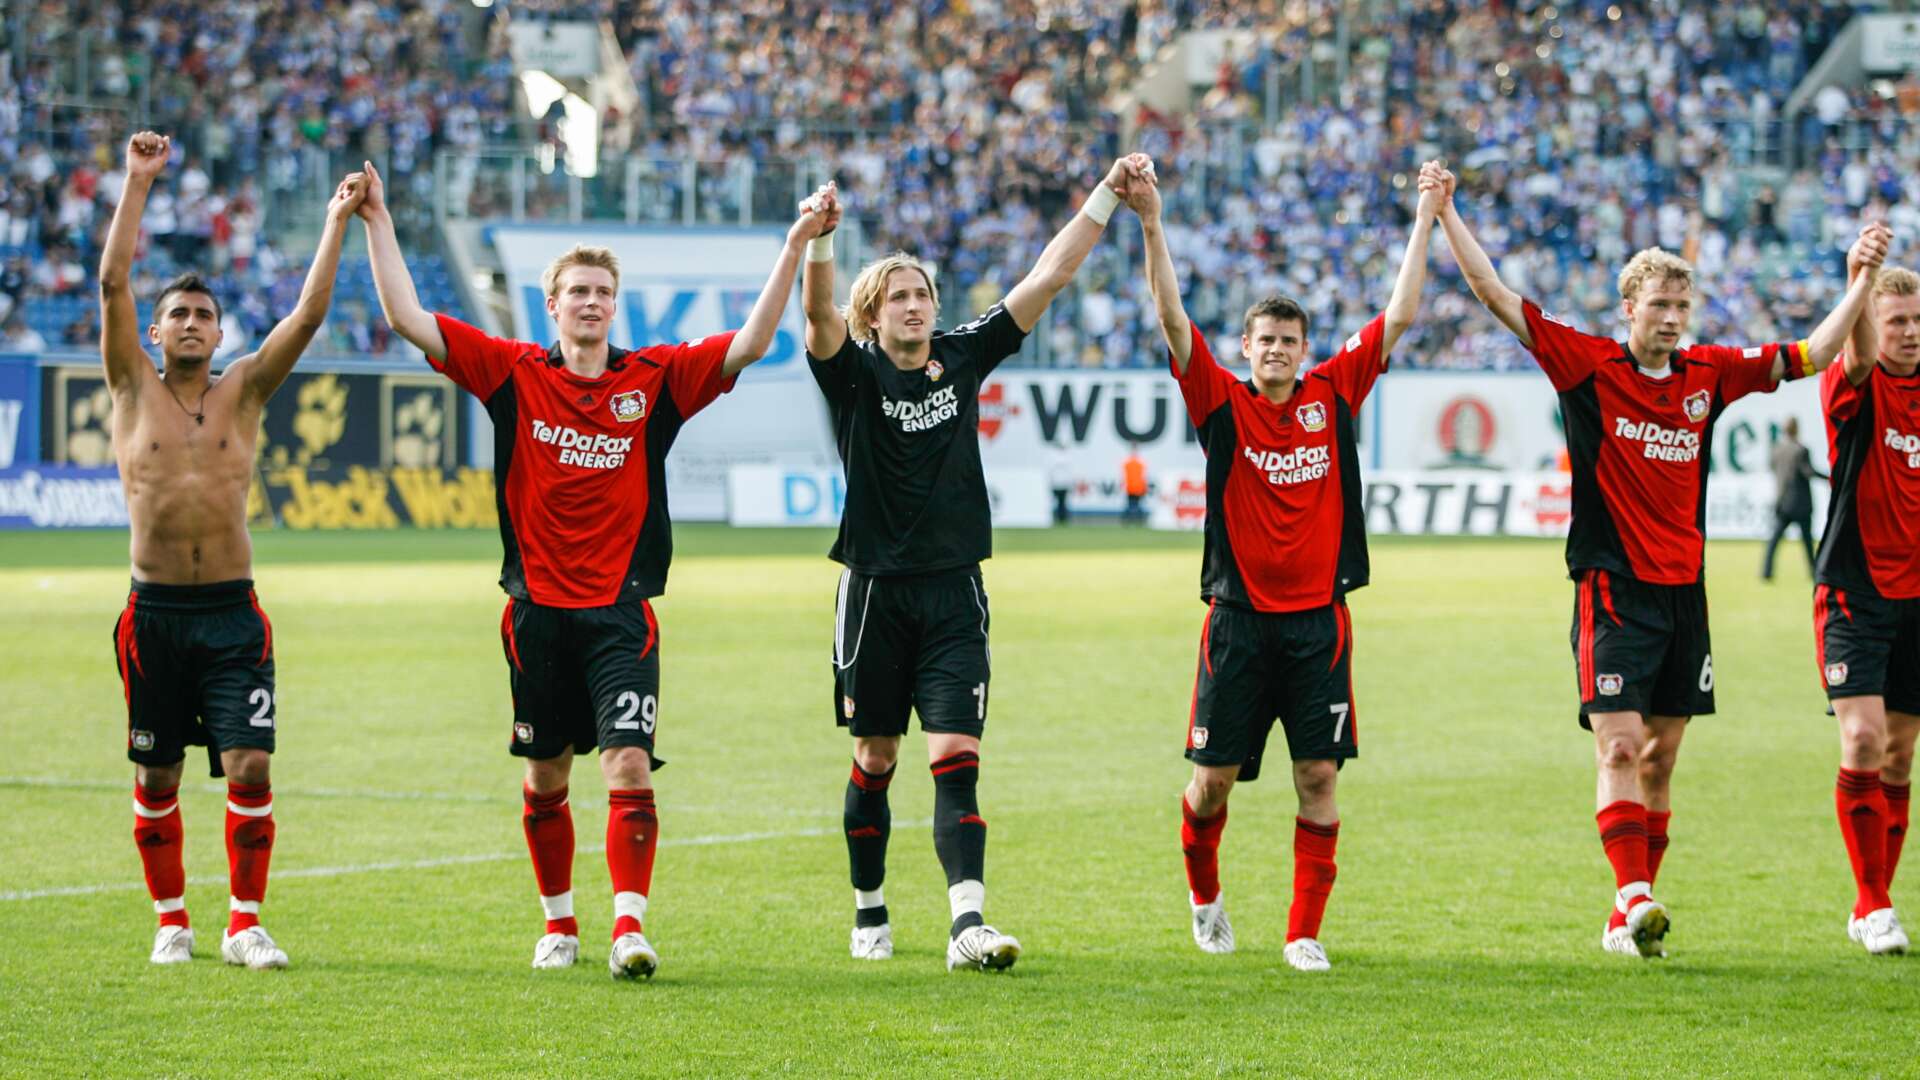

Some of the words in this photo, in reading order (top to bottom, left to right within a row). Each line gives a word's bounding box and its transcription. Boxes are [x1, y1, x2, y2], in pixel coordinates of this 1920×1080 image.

[902, 400, 959, 432] ENERGY
[1615, 416, 1699, 449] TelDaFa
[532, 418, 634, 454] TelDaFax
[1268, 461, 1331, 485] ENERGY
[1698, 653, 1714, 693] 6
[248, 688, 276, 731] 2
[614, 690, 657, 735] 29
[972, 682, 986, 720] 1
[1329, 702, 1350, 744] 7
